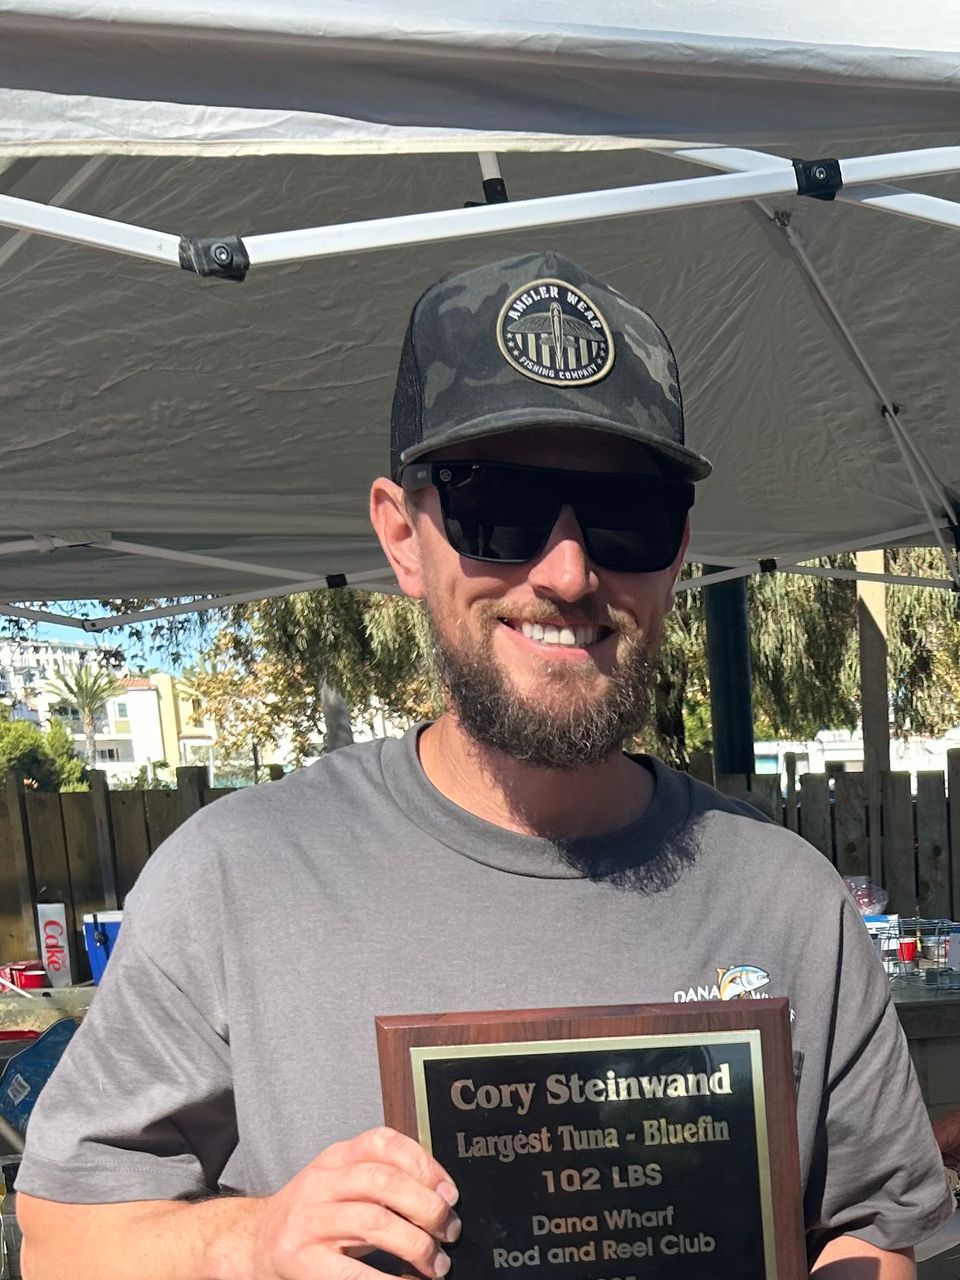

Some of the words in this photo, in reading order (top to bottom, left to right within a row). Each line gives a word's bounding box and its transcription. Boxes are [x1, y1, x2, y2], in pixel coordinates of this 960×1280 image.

[508, 285, 559, 320] ANGLER
[566, 291, 602, 329] WEAR
[519, 356, 555, 377] FISHING
[559, 364, 598, 379] COMPANY
[673, 985, 721, 1003] DANA
[450, 1079, 535, 1115] Cory
[546, 1062, 733, 1105] Steinwand
[457, 1127, 553, 1163] Largest
[558, 1125, 620, 1152] Tuna
[643, 1116, 730, 1146] Bluefin
[542, 1168, 601, 1193] 102
[613, 1163, 663, 1189] LBS
[532, 1215, 598, 1236] Dana
[604, 1206, 674, 1230] Wharf
[493, 1246, 541, 1269] Rod
[548, 1241, 596, 1263] and
[603, 1238, 653, 1260] Reel
[660, 1232, 716, 1255] Club
